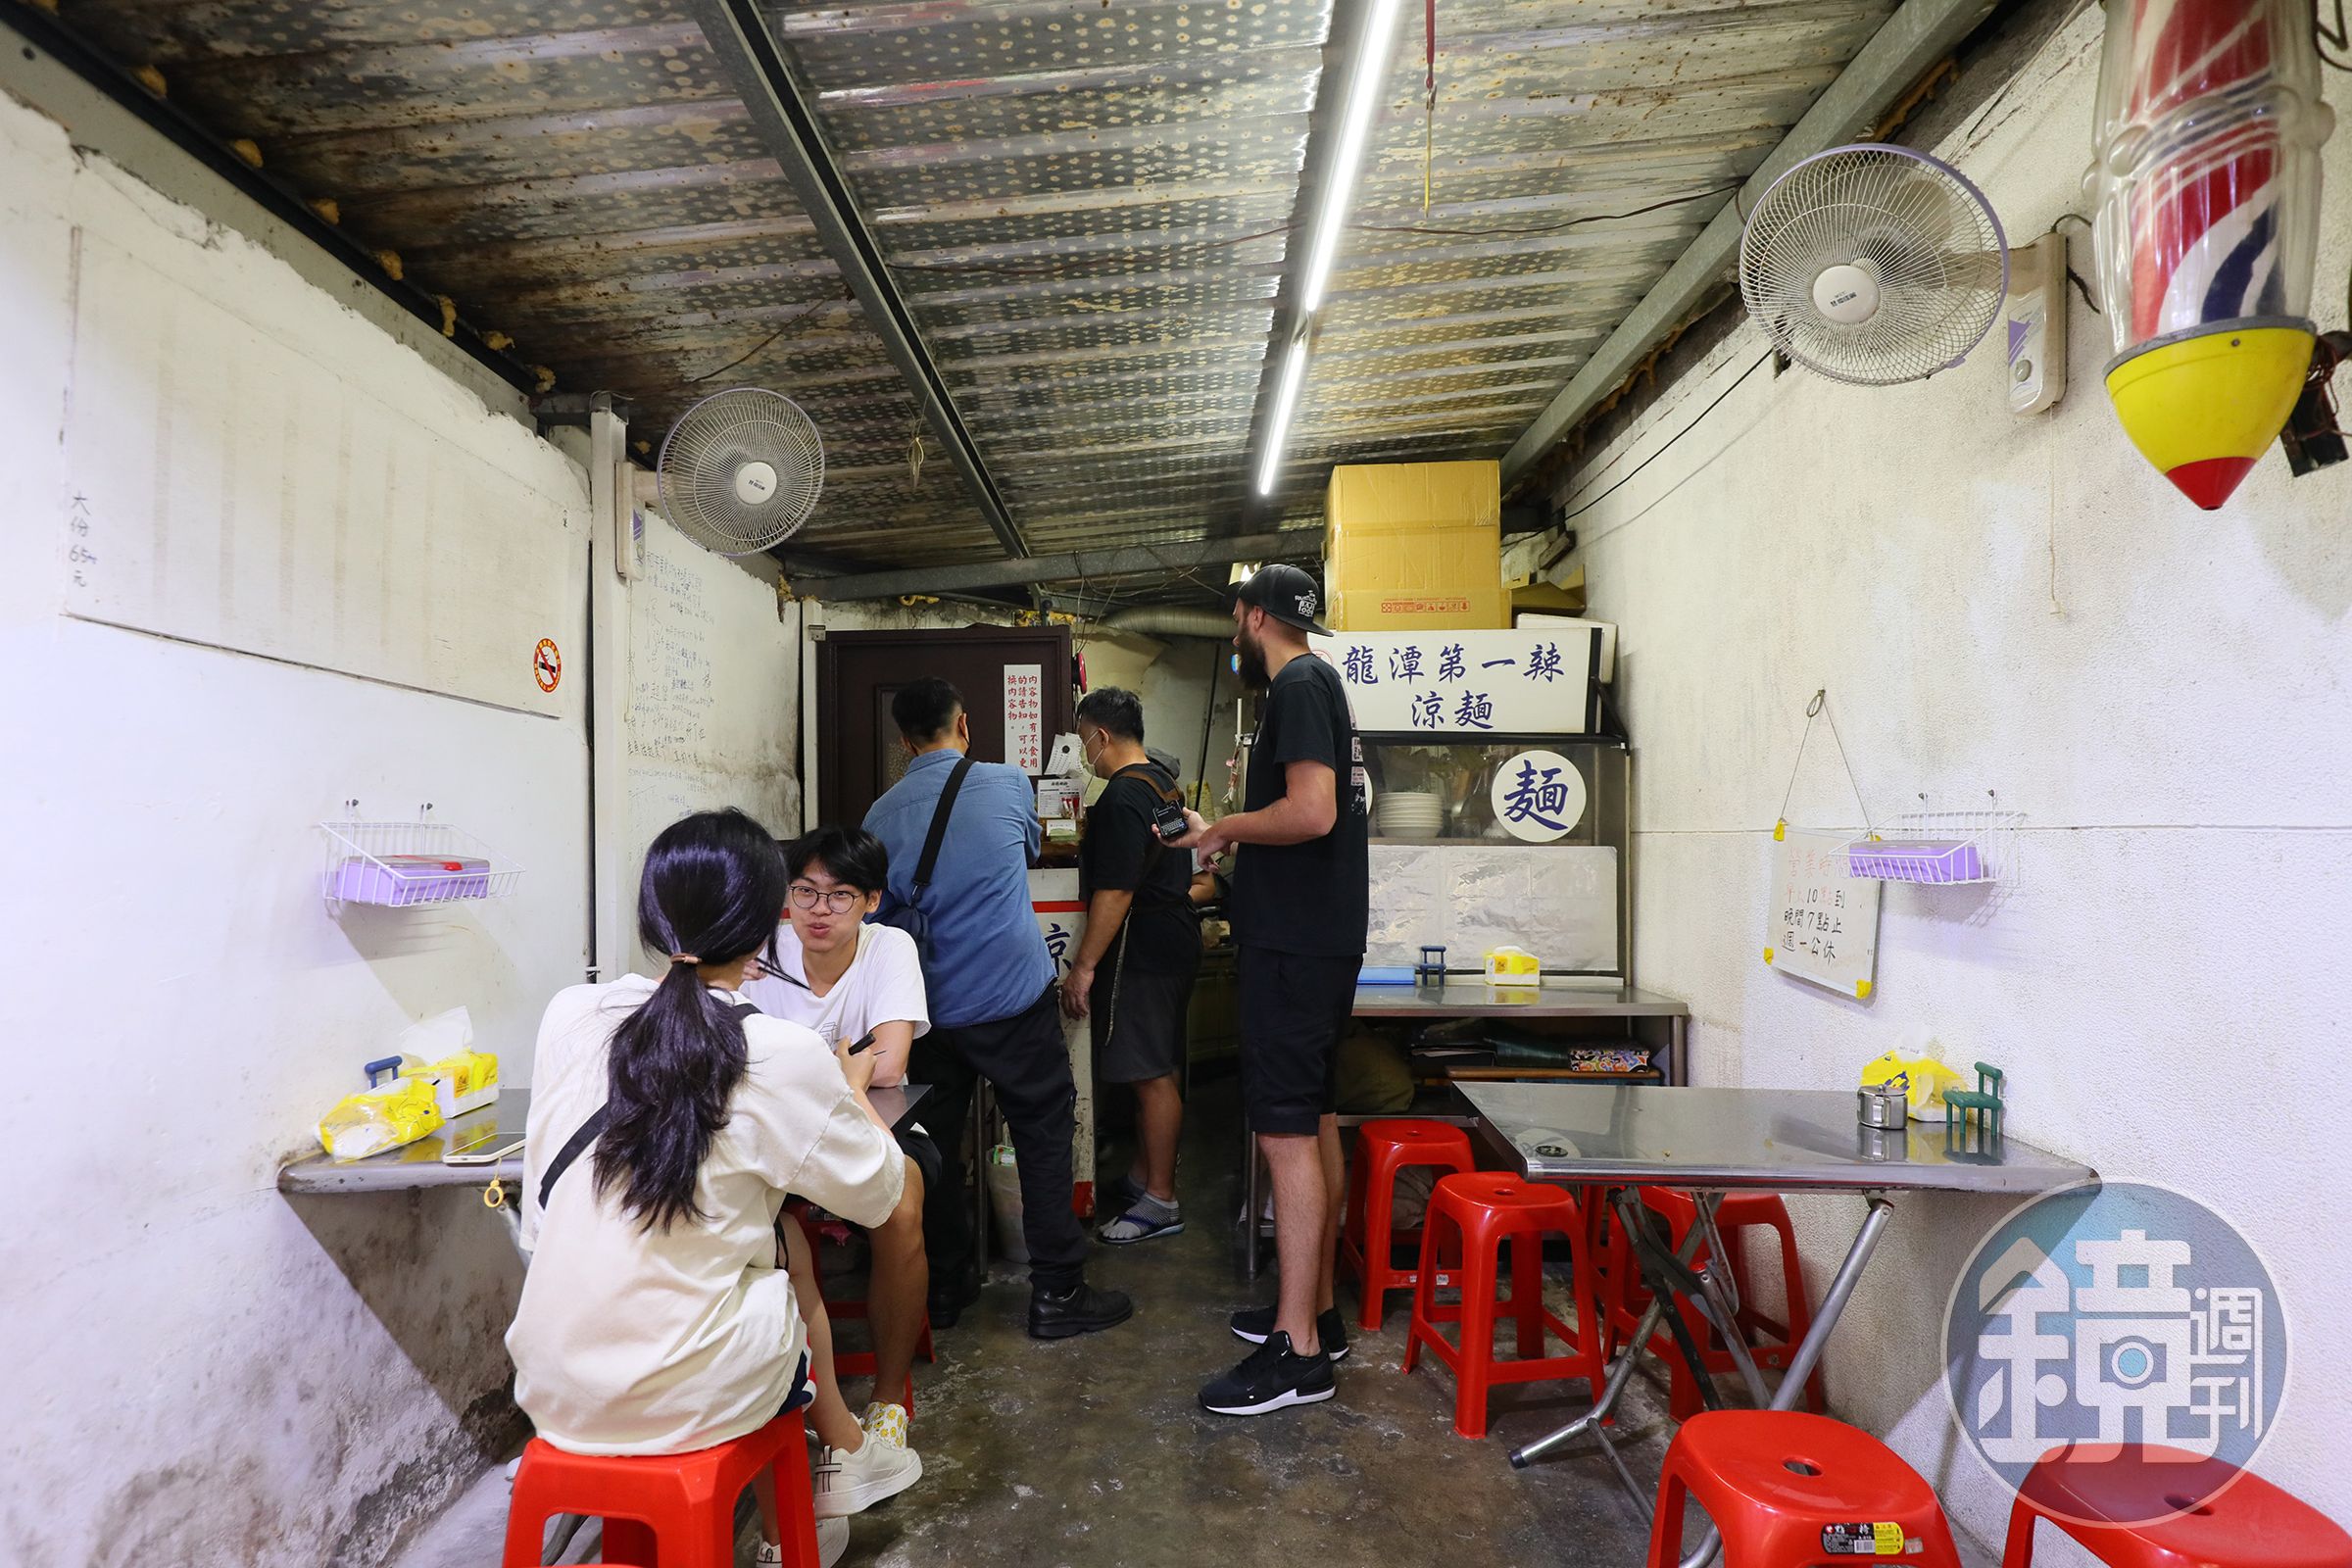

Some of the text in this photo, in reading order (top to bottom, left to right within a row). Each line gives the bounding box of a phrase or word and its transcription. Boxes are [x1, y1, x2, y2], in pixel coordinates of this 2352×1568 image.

[1342, 641, 1565, 685] 龍潭第一辣
[1411, 690, 1494, 729] 涼麵
[1503, 760, 1568, 831] 麵
[1784, 907, 1842, 934] 晚間7點止
[1782, 930, 1837, 966] 週一公休
